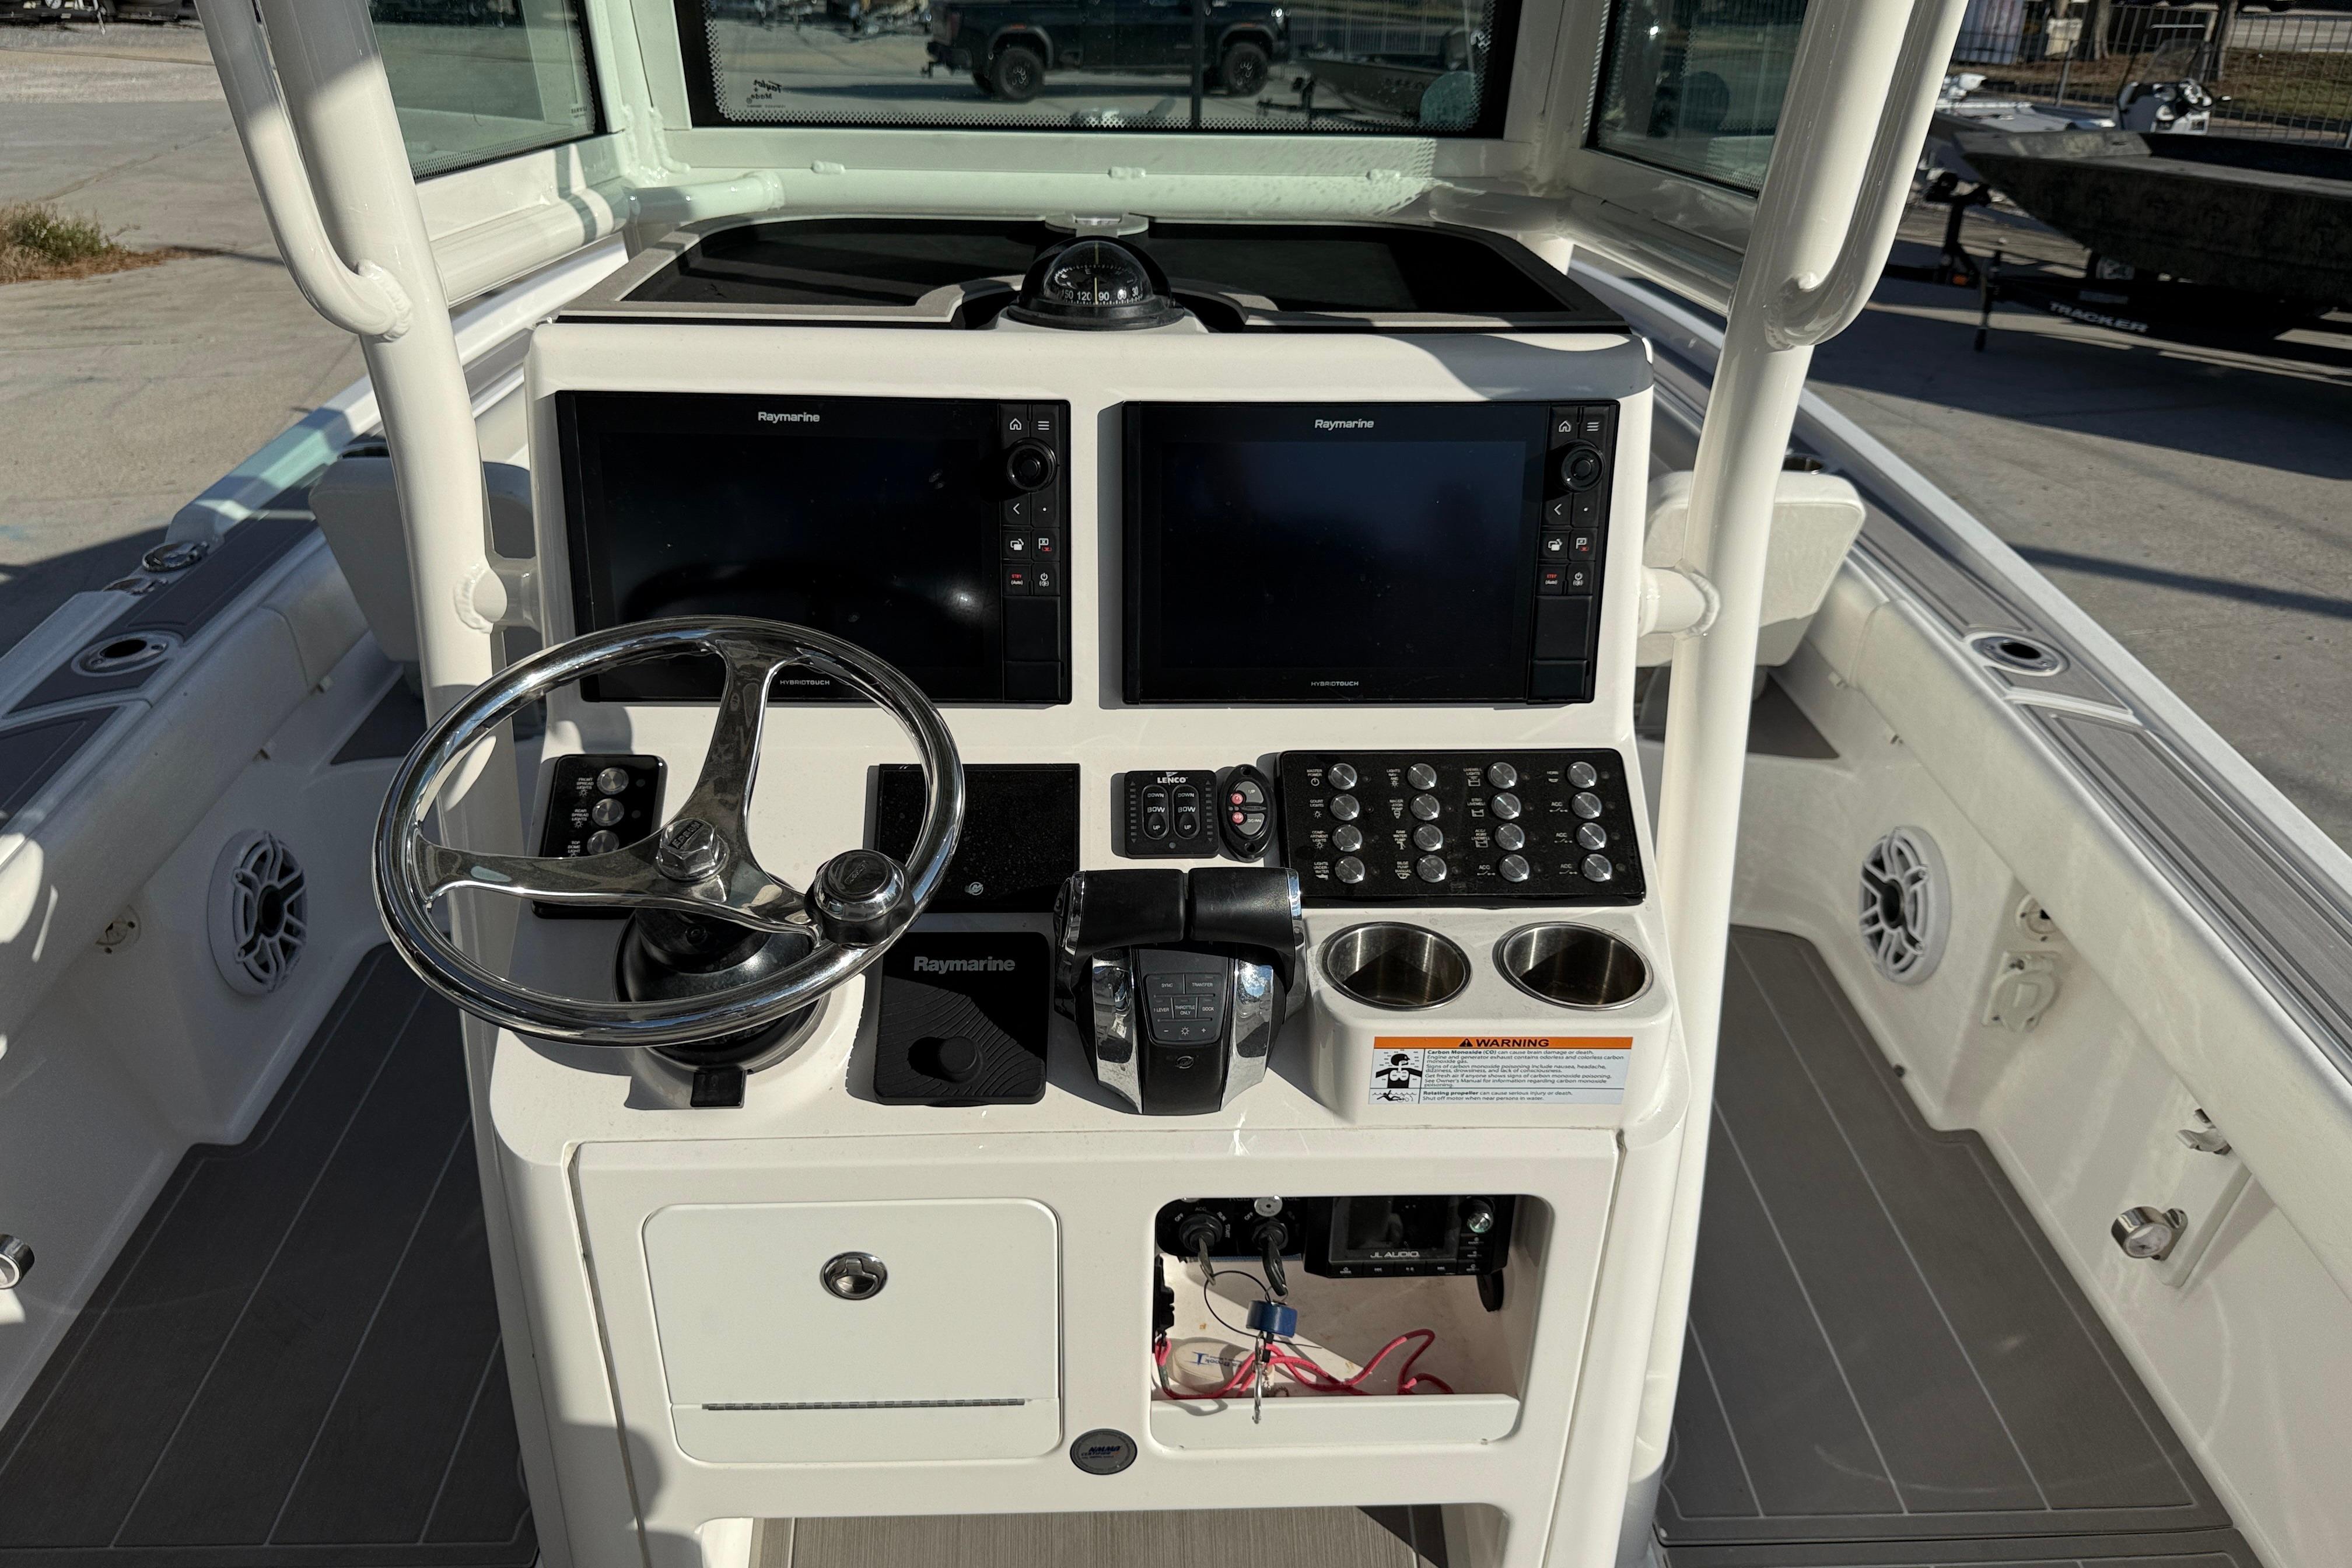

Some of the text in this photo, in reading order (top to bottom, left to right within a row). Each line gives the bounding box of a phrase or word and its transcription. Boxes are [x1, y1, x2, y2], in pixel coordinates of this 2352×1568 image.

[1077, 292, 1092, 301] 120
[1098, 292, 1110, 301] 90
[2049, 301, 2149, 333] TRACKER
[758, 411, 820, 424] Raymarine
[1314, 419, 1374, 431] Raymarine
[914, 956, 1016, 974] Raymarine
[1476, 1039, 1549, 1047] WARNING
